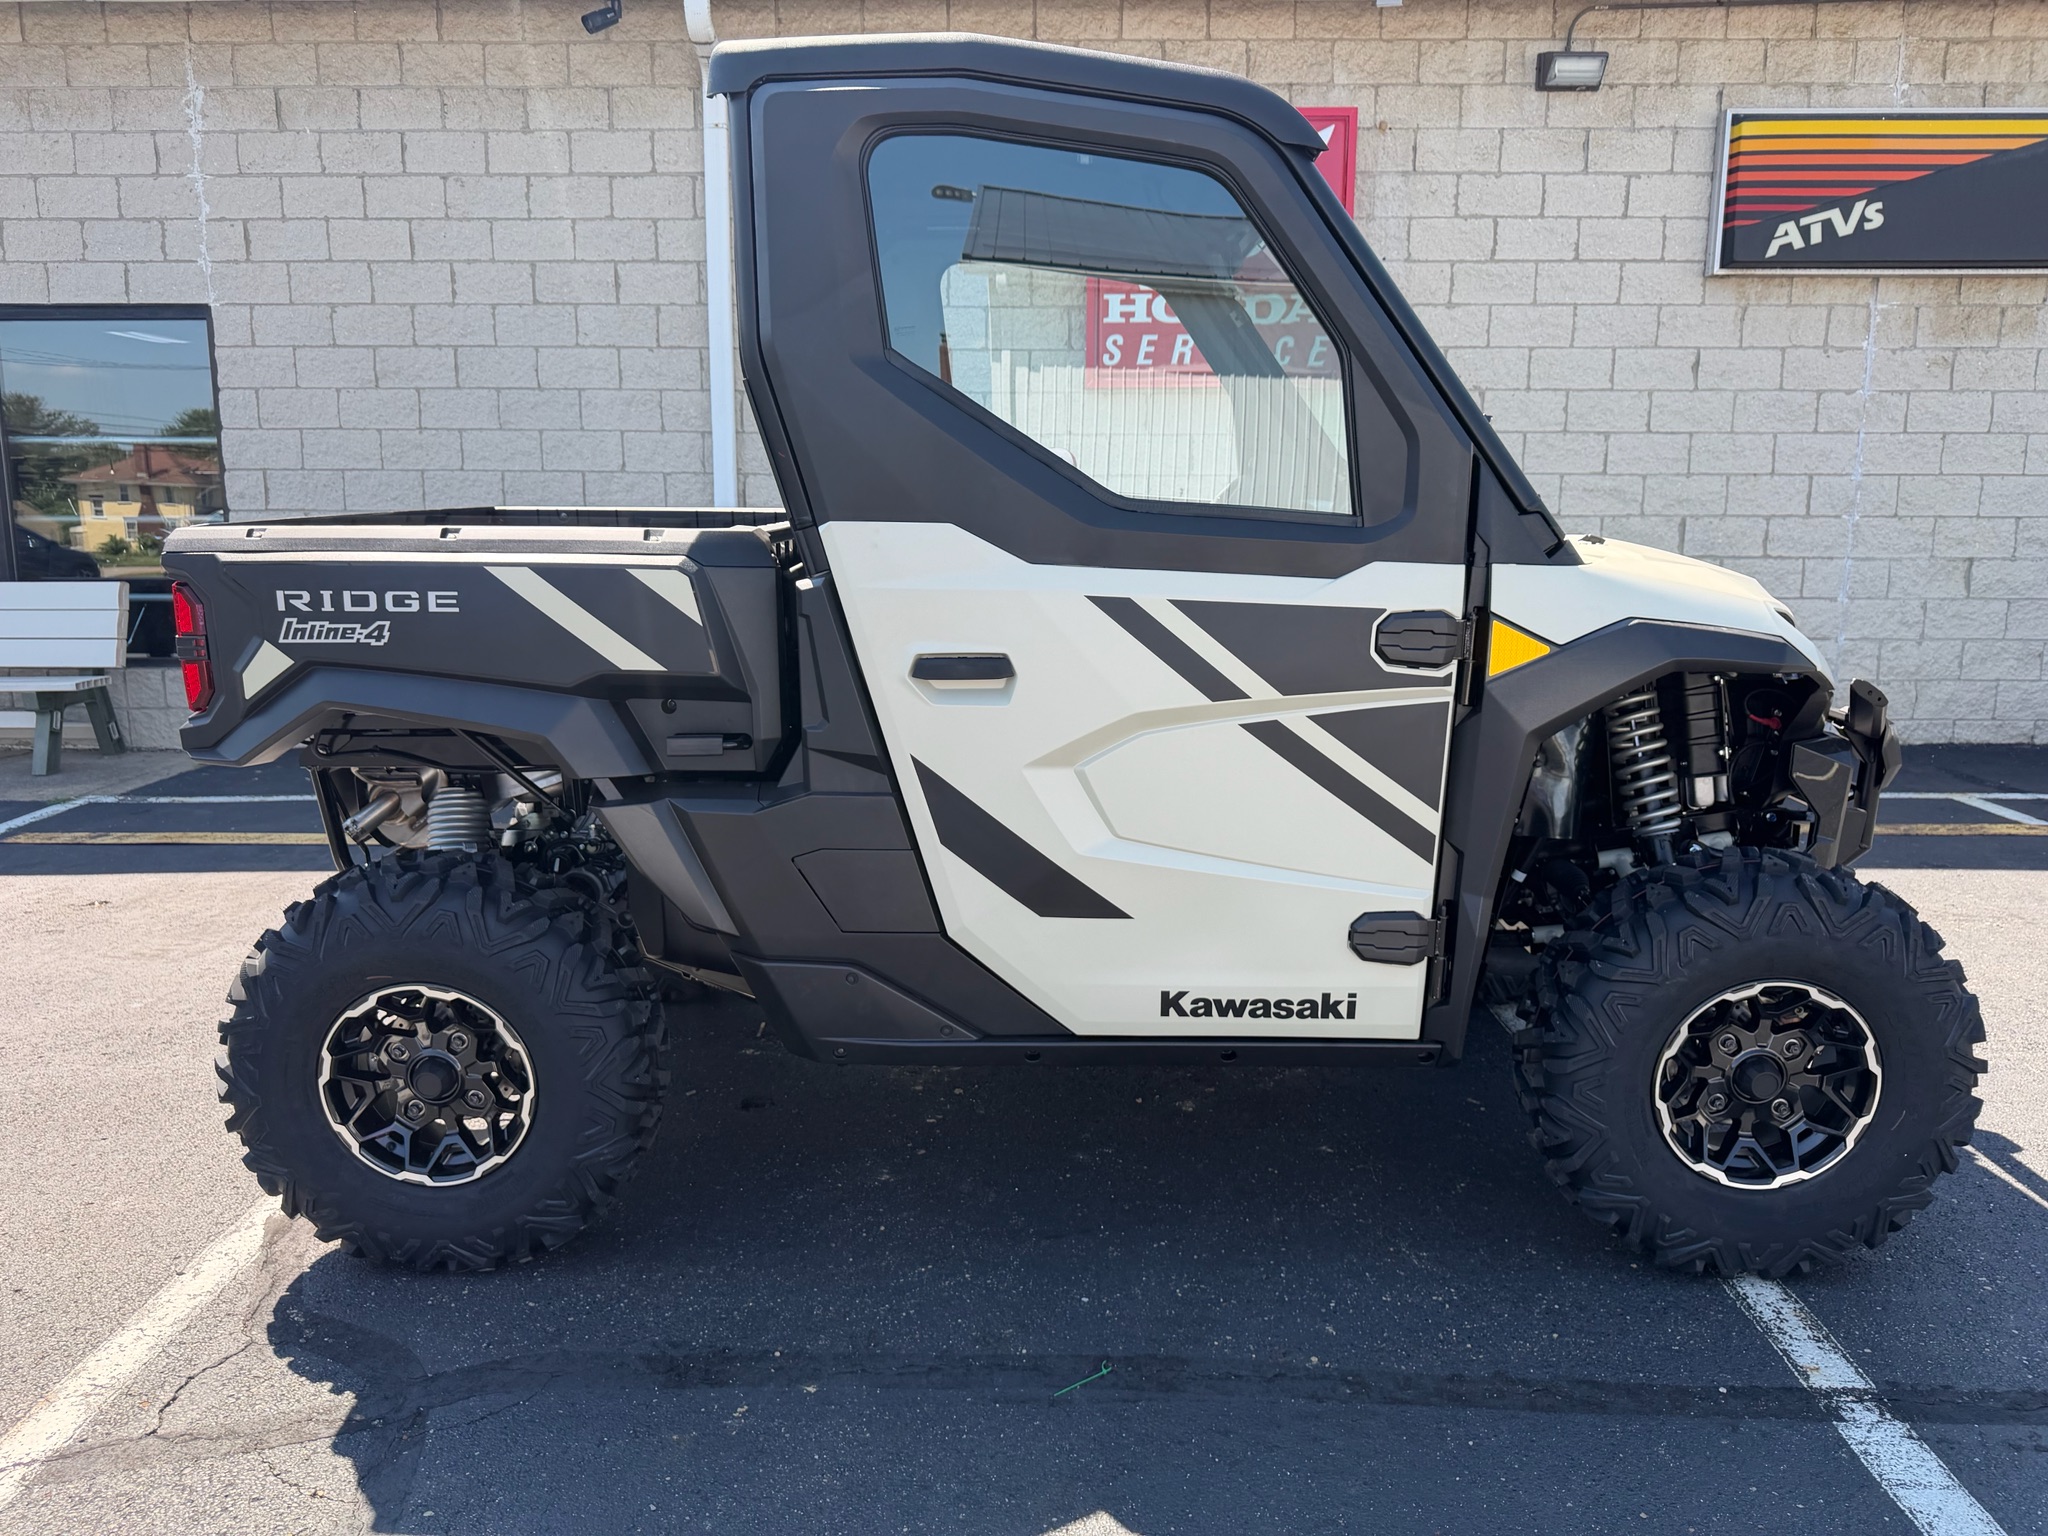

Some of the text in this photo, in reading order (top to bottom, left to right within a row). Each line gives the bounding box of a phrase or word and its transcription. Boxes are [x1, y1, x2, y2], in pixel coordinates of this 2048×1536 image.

[1103, 292, 1320, 325] HODA
[1103, 333, 1329, 368] SERCE
[275, 590, 460, 612] RIDGE
[278, 617, 391, 646] Inline-4
[1160, 990, 1357, 1019] Kawasaki
